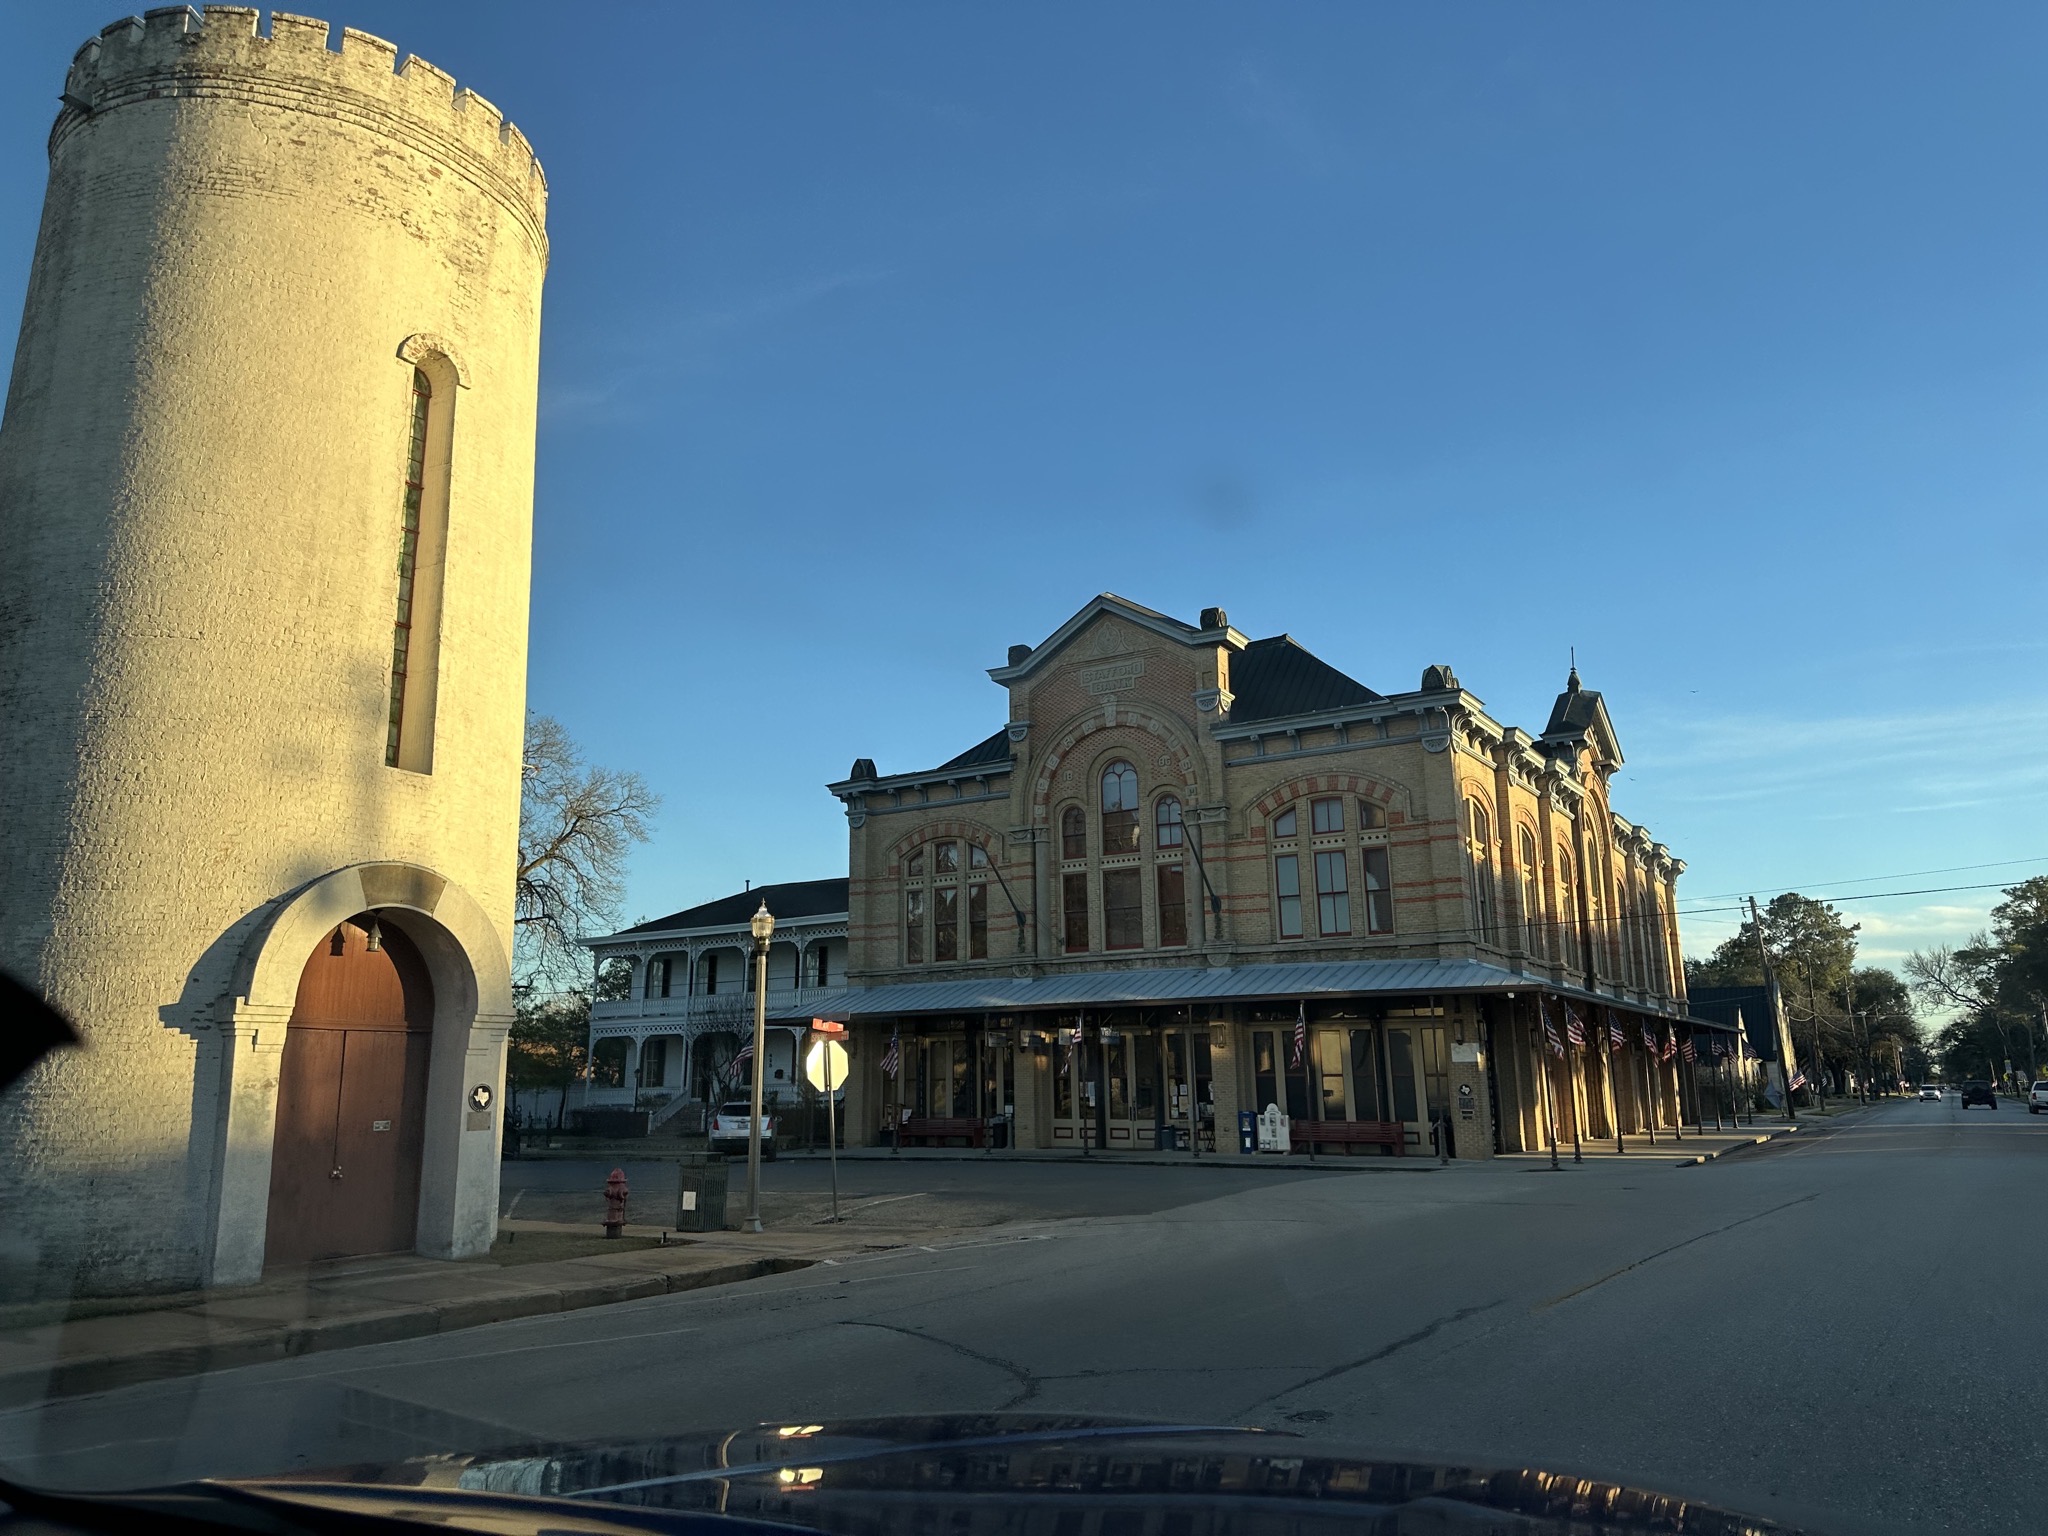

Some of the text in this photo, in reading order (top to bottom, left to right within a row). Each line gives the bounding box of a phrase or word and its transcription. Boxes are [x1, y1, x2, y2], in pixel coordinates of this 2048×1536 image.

[1083, 662, 1141, 683] STAFFORD
[1094, 678, 1132, 692] BANK
[1158, 755, 1171, 767] 86
[1063, 770, 1073, 782] 18
